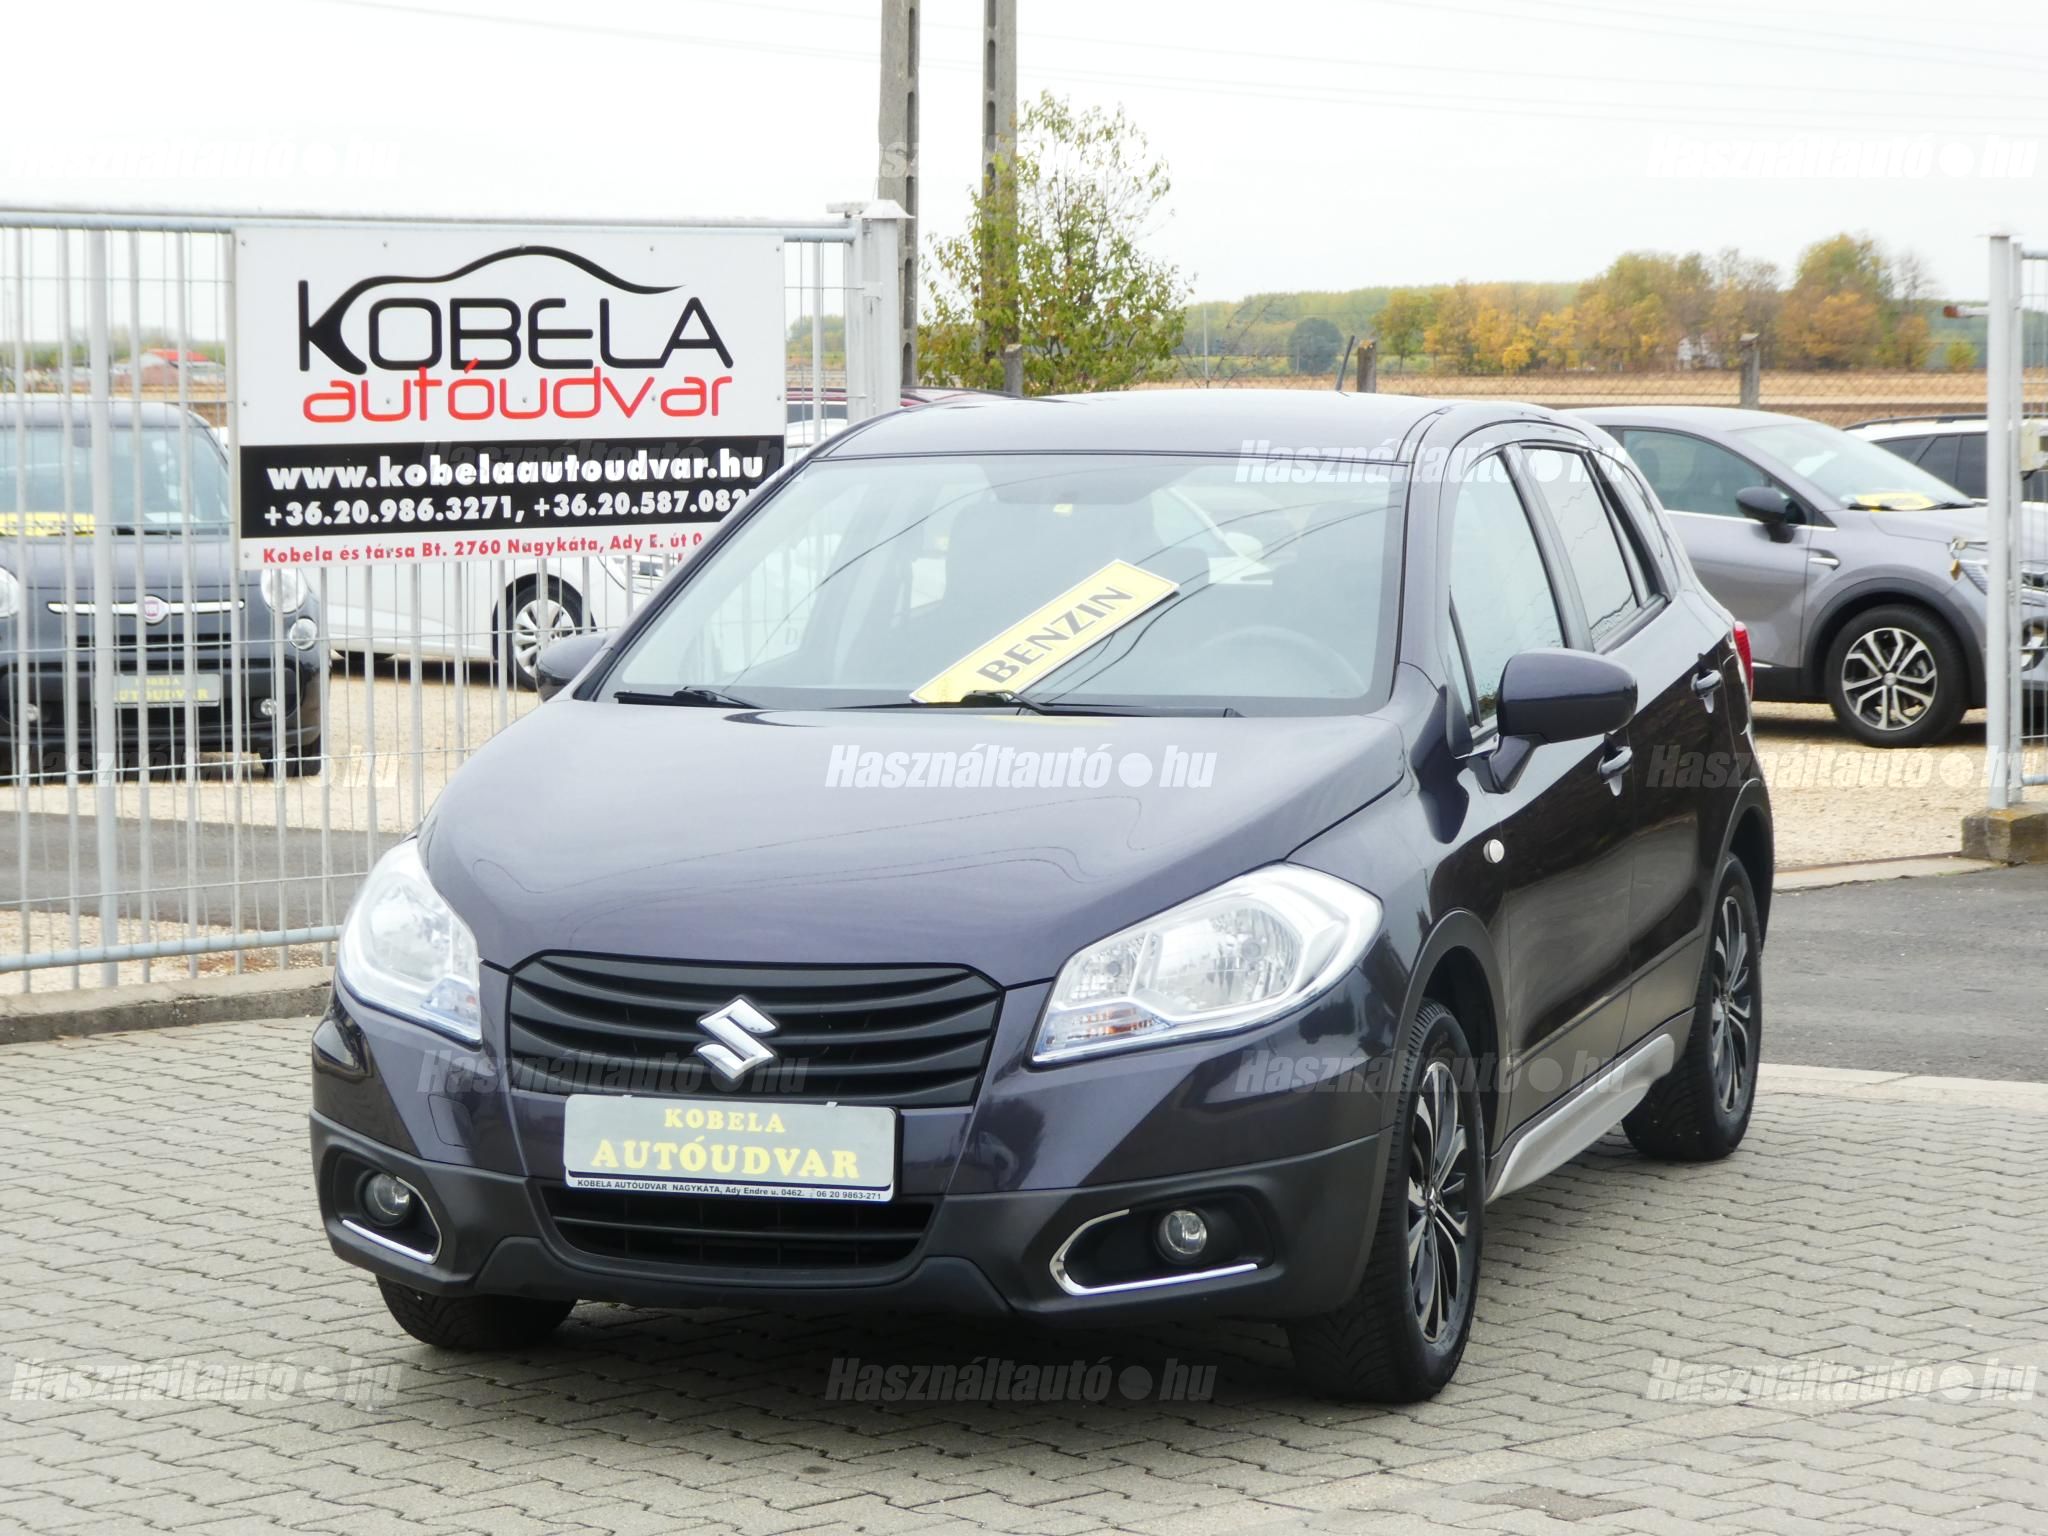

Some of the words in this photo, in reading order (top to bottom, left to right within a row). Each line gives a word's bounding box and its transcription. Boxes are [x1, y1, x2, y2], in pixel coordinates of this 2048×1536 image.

[298, 278, 733, 375] KOBELA
[303, 357, 733, 423] autóudvar
[266, 448, 763, 490] www.kobelaautoudvar.hu
[264, 495, 525, 526] +36.20.986.3271,
[534, 488, 757, 517] +36.20.587.082
[263, 546, 332, 563] Kobela
[340, 544, 359, 560] és
[365, 543, 415, 559] társa
[422, 542, 447, 557] Bt.
[454, 540, 501, 556] 2760
[507, 536, 604, 556] Nagykáta,
[610, 535, 643, 551] Ady
[650, 534, 664, 549] E.
[976, 586, 1133, 684] BENZIN
[664, 1107, 787, 1134] KOBELA
[591, 1136, 860, 1179] AUTÓUDVAR
[577, 1179, 612, 1188] KOBELA
[725, 1186, 741, 1196] Ady
[743, 1187, 769, 1196] Endre
[816, 1190, 827, 1198] 06
